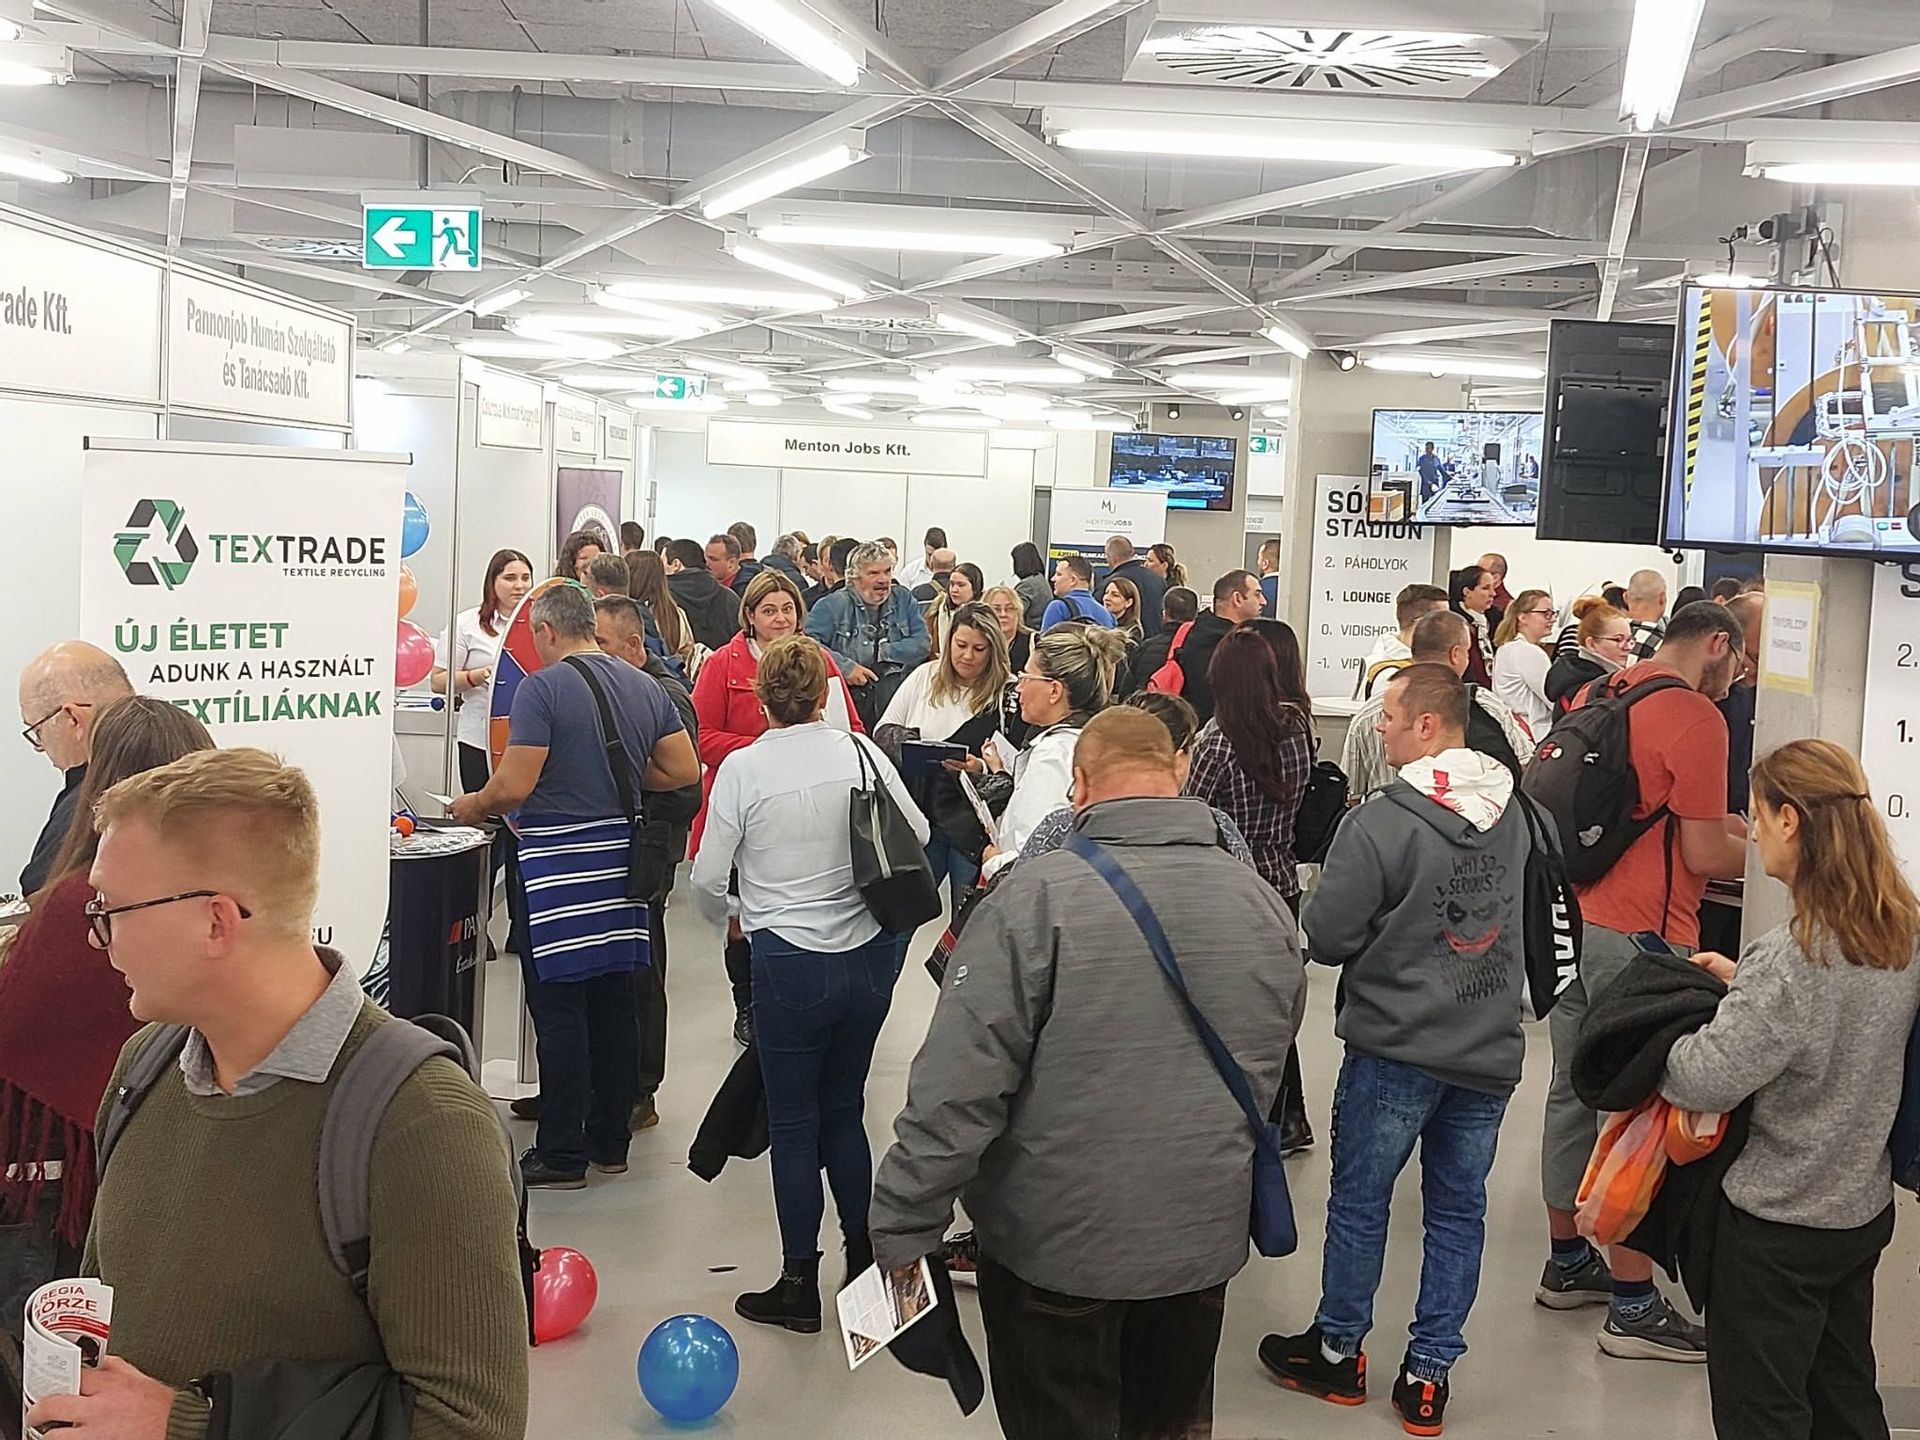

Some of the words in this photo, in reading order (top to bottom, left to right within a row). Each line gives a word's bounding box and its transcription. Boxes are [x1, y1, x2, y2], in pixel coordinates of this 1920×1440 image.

[43, 290, 72, 335] Kft.
[187, 297, 248, 350] Pannonjob
[250, 315, 286, 354] Humán
[287, 324, 336, 367] Szolgáltató
[222, 351, 237, 388] és
[239, 356, 292, 397] Tanácsadó
[293, 369, 310, 399] Kft.
[784, 437, 841, 453] Menton
[844, 441, 881, 455] Jobs
[885, 443, 912, 457] Kft.
[1327, 484, 1368, 514] SÓ
[1326, 518, 1423, 540] STADION
[208, 534, 386, 565] TEXTRADE
[282, 567, 327, 577] TEXTILE
[330, 567, 386, 578] RECYCLING
[1324, 556, 1336, 569] 2.
[1344, 554, 1409, 571] PÁHOLYOK
[1325, 590, 1334, 602] 1.
[1343, 590, 1392, 604] LOUNGE
[114, 616, 158, 653] ÚJ
[169, 616, 290, 651] ÉLETET
[1321, 624, 1333, 636] 0.
[1316, 657, 1330, 670] -1.
[1340, 657, 1360, 670] VIP
[1896, 643, 1919, 669] 2.
[149, 661, 230, 684] ADUNK
[237, 660, 254, 681] A
[261, 654, 375, 680] HASZNÁLT
[172, 687, 382, 725] XTÍLIÁKNAK
[1896, 719, 1914, 743] 1.
[1887, 794, 1910, 819] 0.
[1451, 855, 1478, 877] WHY
[40, 1286, 85, 1304] REGIA
